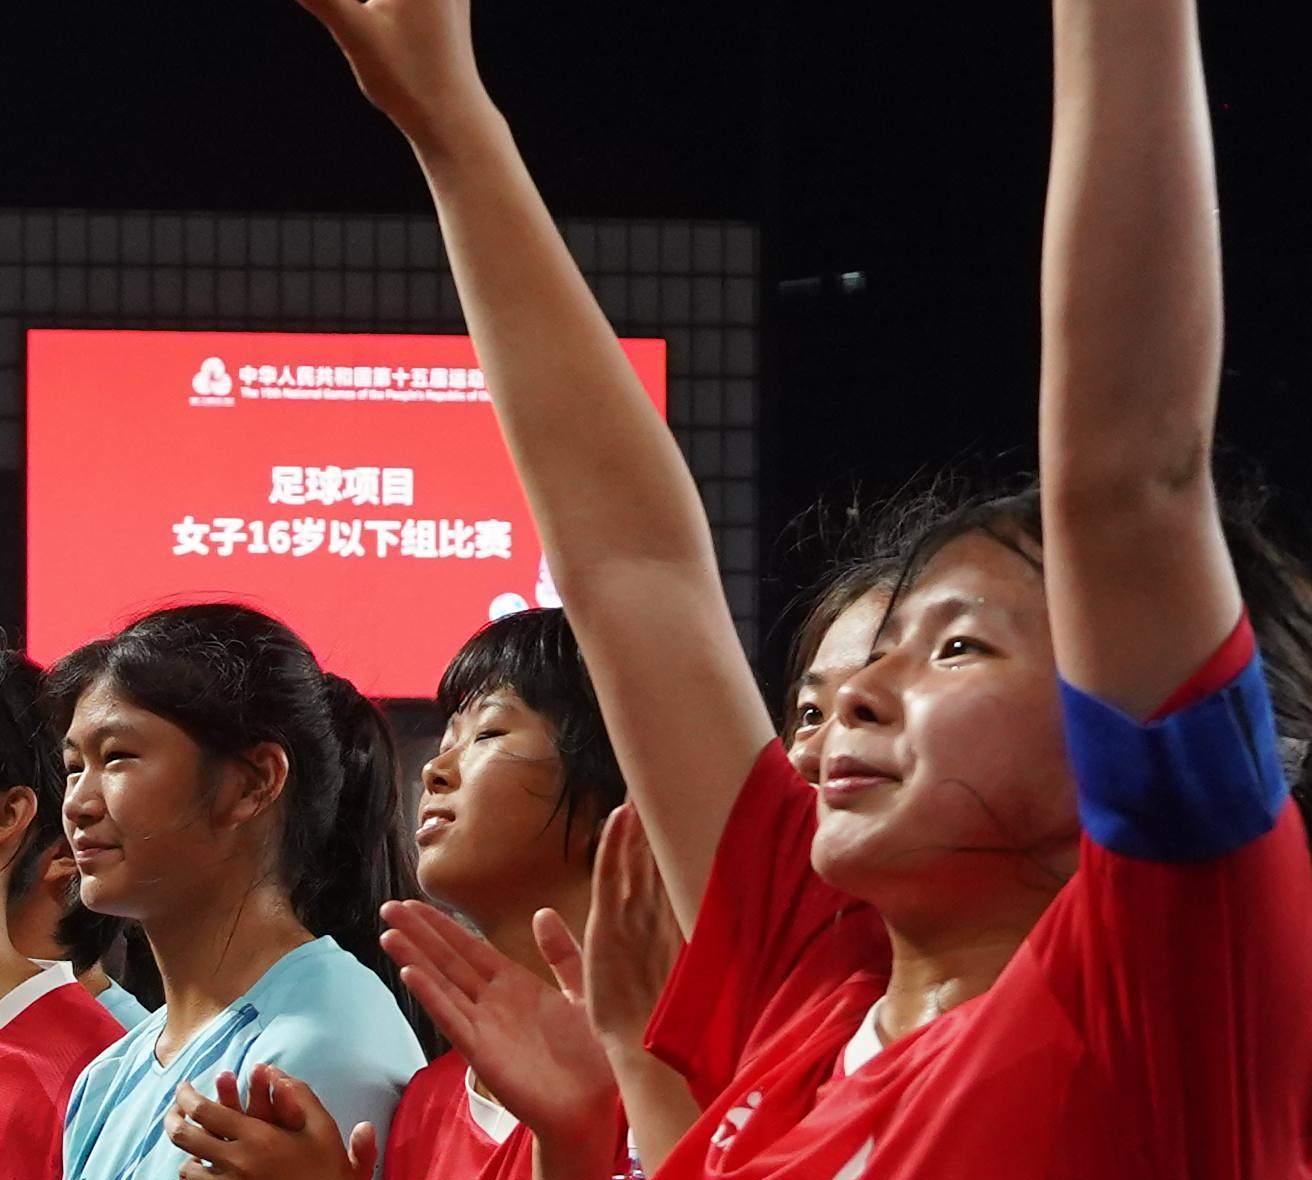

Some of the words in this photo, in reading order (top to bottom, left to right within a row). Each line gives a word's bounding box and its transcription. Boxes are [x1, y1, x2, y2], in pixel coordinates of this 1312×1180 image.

[268, 466, 414, 506] 足球项目
[172, 518, 512, 560] 女子16岁以下组比赛
